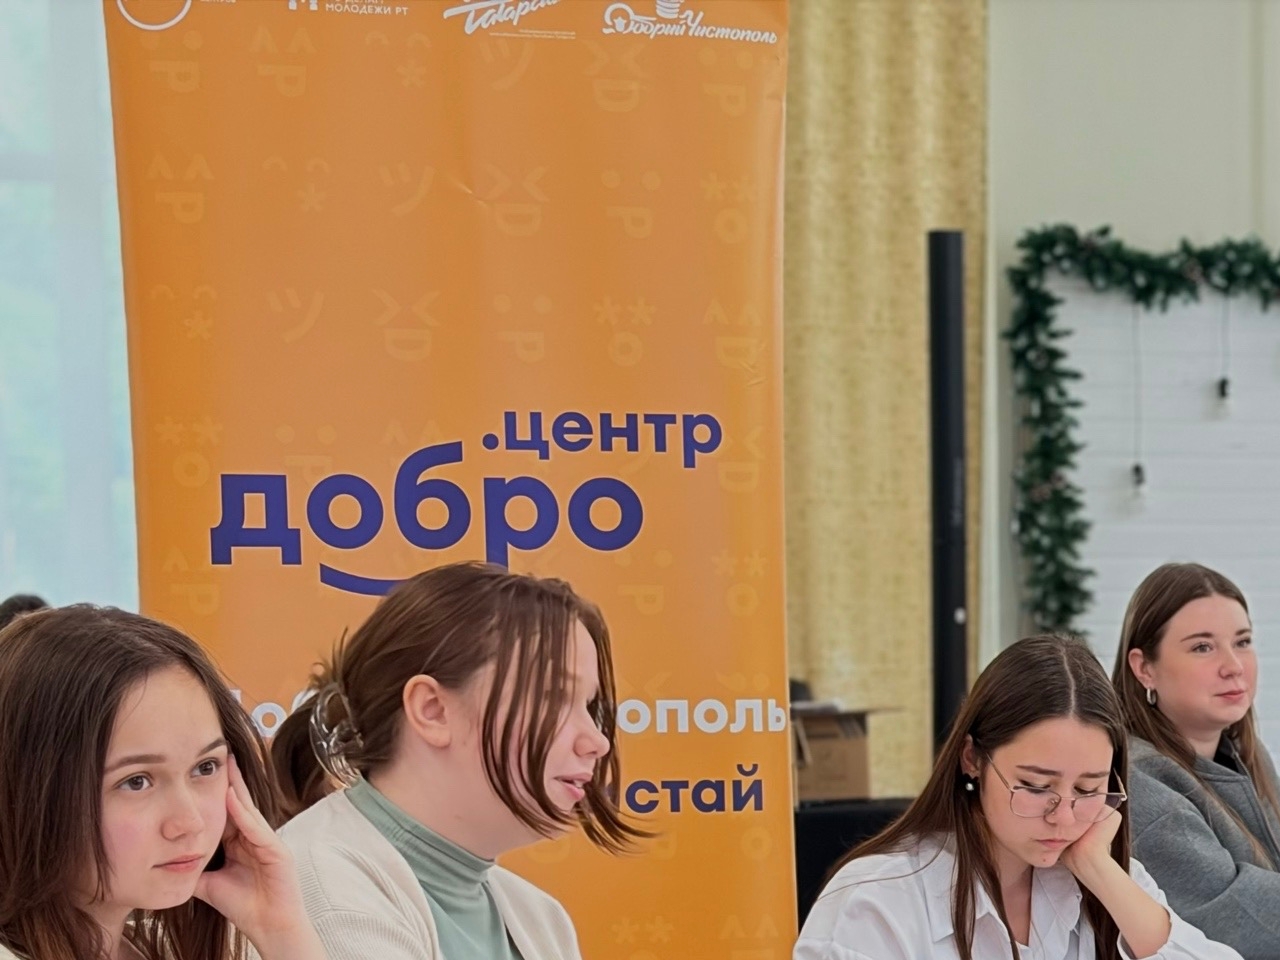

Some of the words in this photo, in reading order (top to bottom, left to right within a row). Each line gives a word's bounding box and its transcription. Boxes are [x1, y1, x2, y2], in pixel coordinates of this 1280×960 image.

[325, 3, 391, 14] МОЛОДЕЖИ
[395, 7, 409, 15] РТ
[679, 10, 778, 44] Чистополь
[210, 441, 644, 570] добро
[617, 698, 787, 734] ополь
[625, 763, 764, 814] стай
